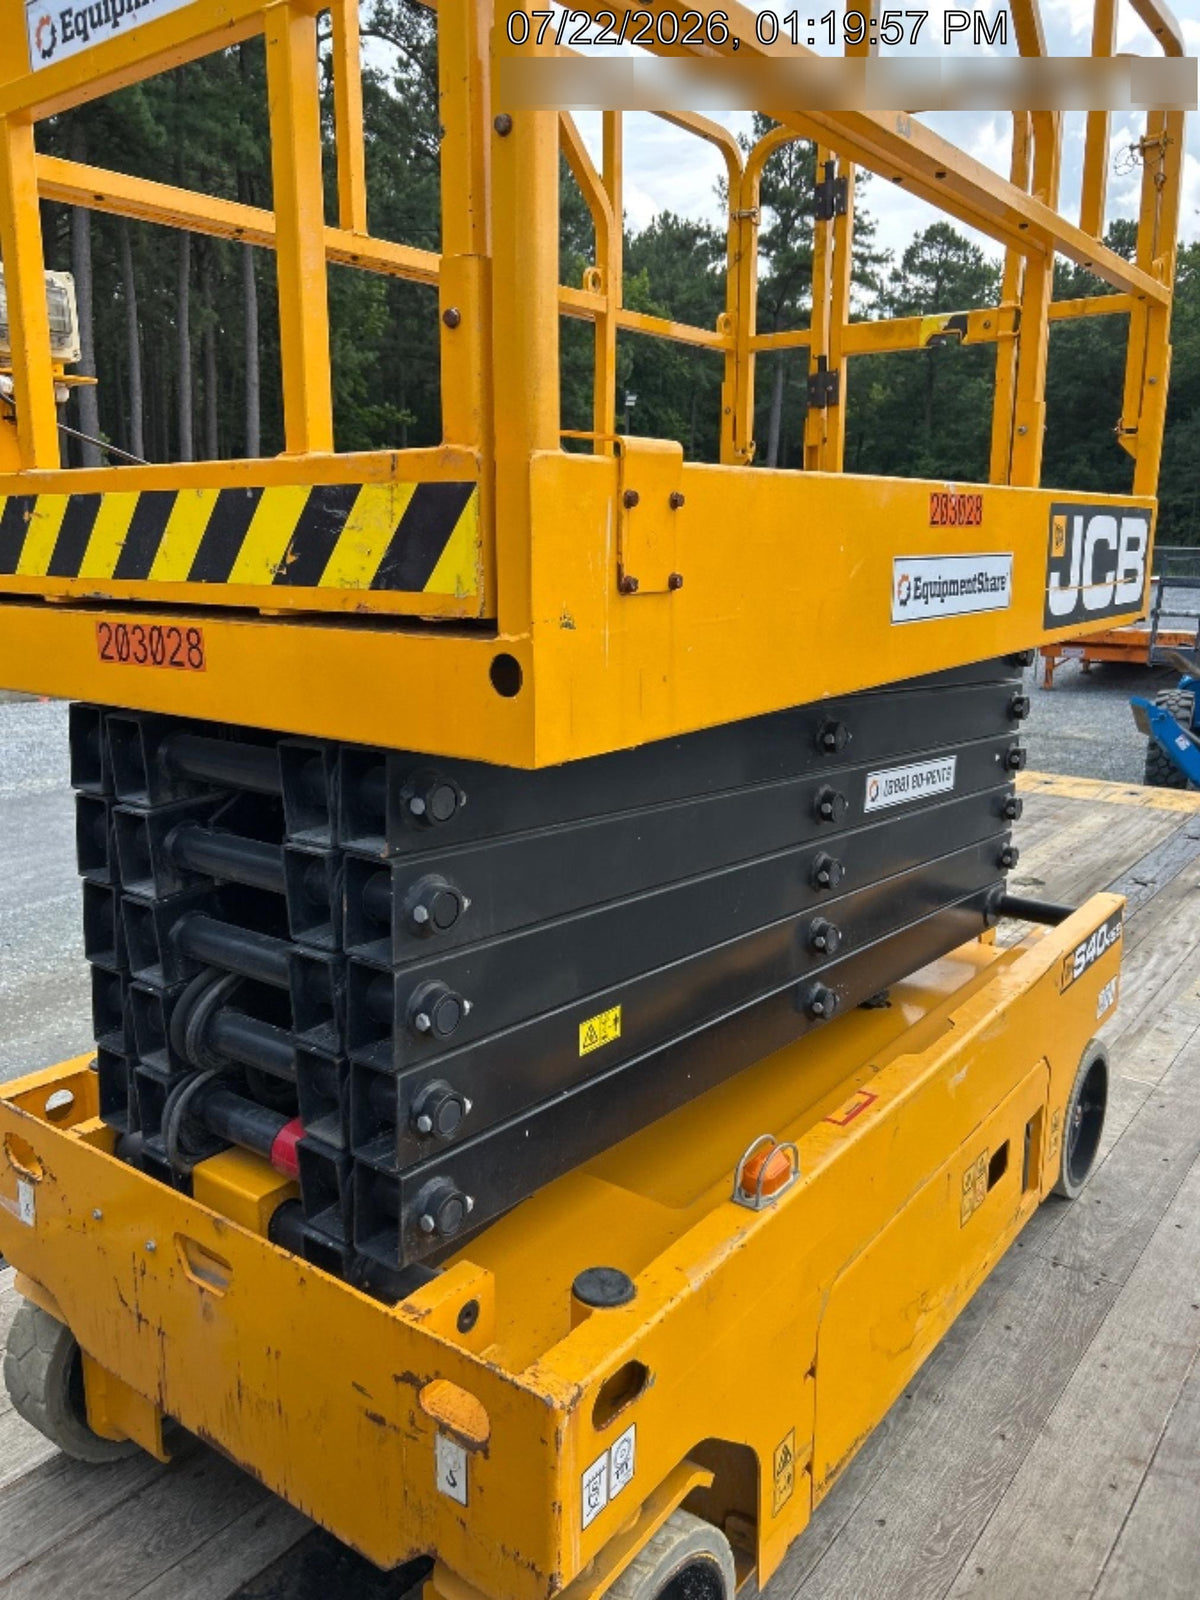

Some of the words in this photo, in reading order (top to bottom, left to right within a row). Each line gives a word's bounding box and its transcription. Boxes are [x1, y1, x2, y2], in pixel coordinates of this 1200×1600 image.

[930, 493, 982, 526] 203028
[1048, 514, 1149, 616] JCB
[913, 572, 1007, 605] EquipmentShare
[98, 622, 203, 669] 203028
